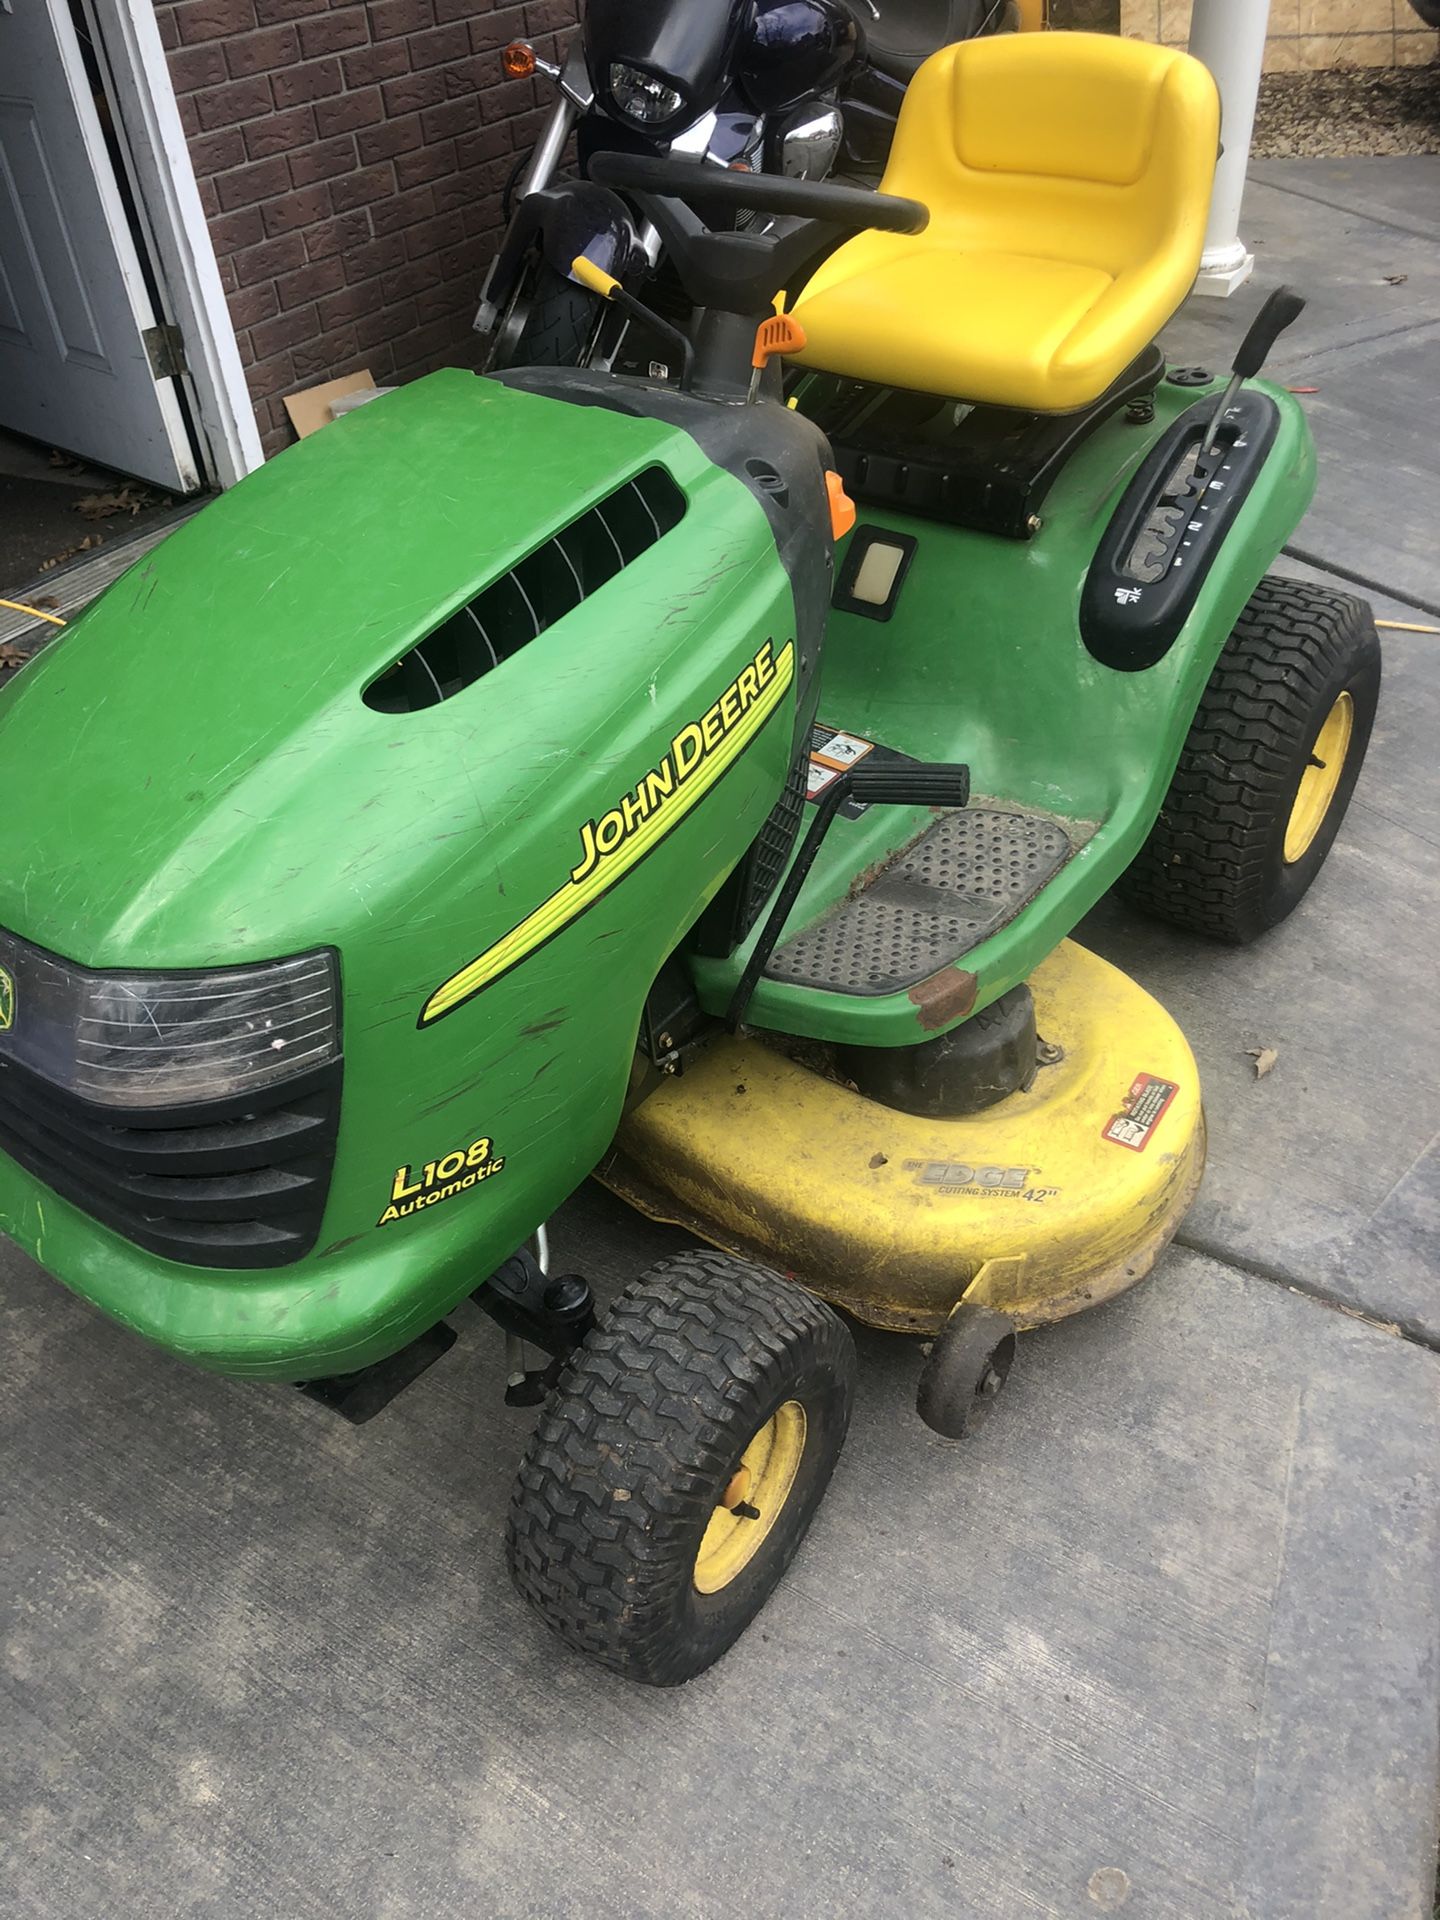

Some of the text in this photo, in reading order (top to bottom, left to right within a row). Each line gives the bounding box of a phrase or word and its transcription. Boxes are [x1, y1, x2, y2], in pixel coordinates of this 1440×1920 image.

[571, 638, 776, 883] JOHN DEERE
[378, 1157, 504, 1226] Automatic
[391, 1137, 490, 1201] L108
[920, 1162, 1029, 1190] EDGE
[938, 1186, 979, 1197] CUTTING
[979, 1188, 1021, 1199] SYSTEM
